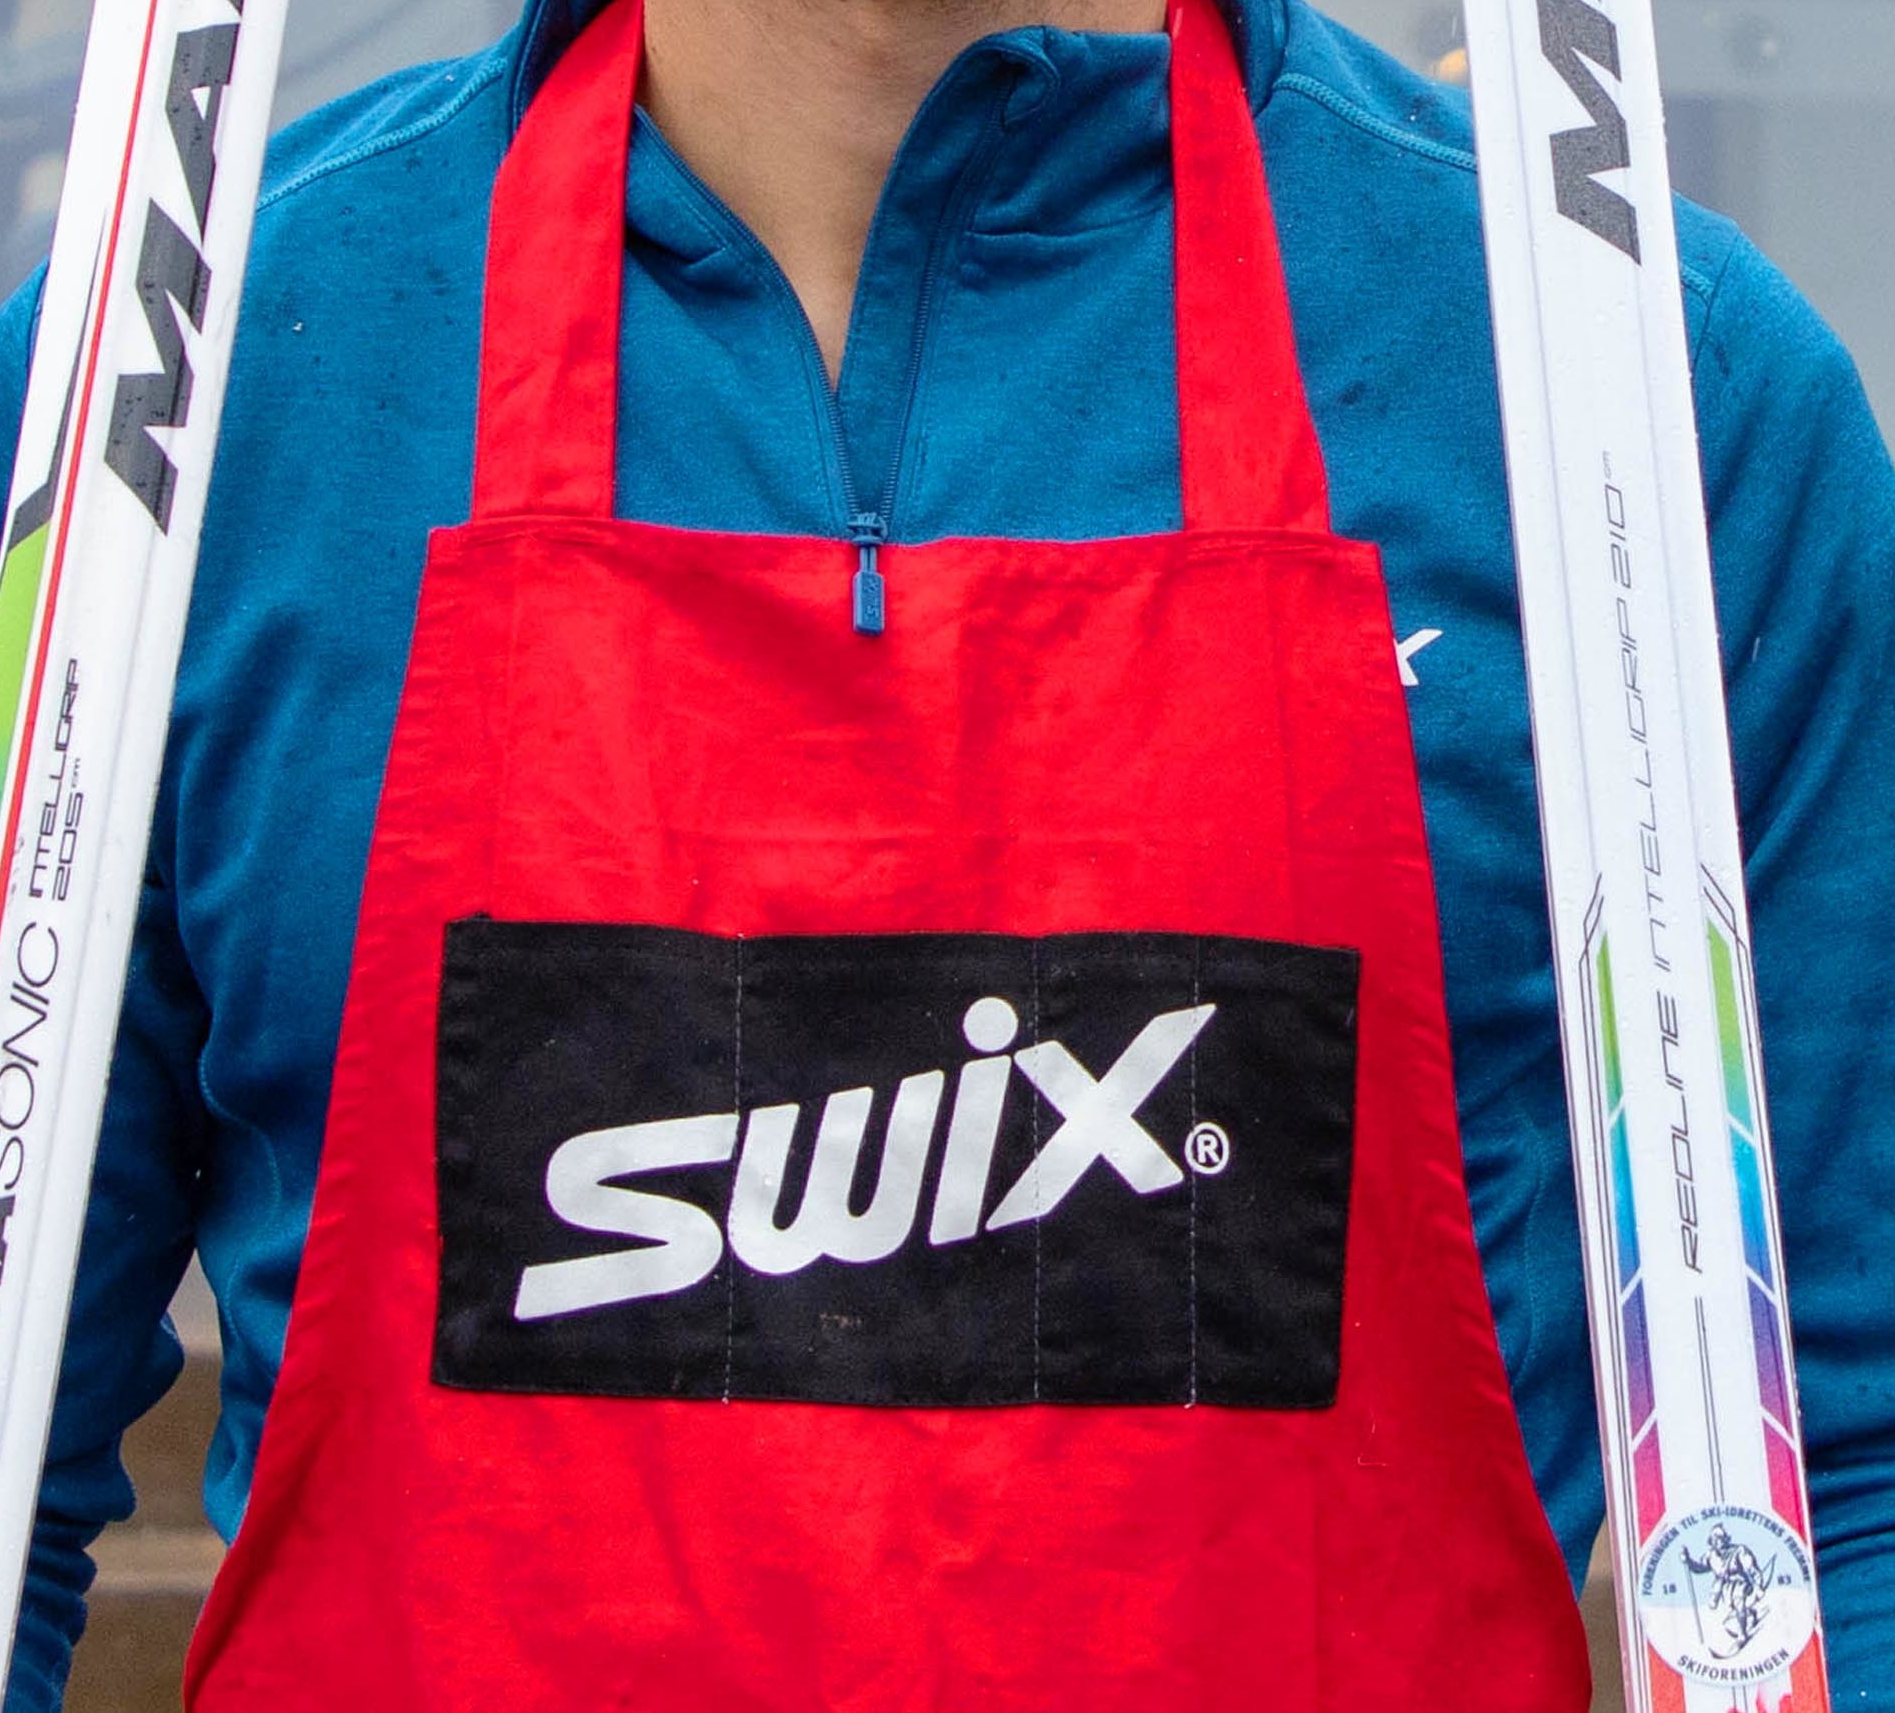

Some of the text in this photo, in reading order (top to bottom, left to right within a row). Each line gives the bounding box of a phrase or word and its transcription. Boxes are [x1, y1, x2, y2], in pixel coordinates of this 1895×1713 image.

[1605, 483, 1633, 590] 210
[28, 658, 80, 899] INTELLIGRIP
[1616, 597, 1672, 974] INTELLIGRIP
[52, 792, 84, 902] 205
[1657, 989, 1703, 1275] REDLINE
[1680, 1514, 1699, 1530] TIL
[1677, 1646, 1790, 1682] SKIFORENINGEN
